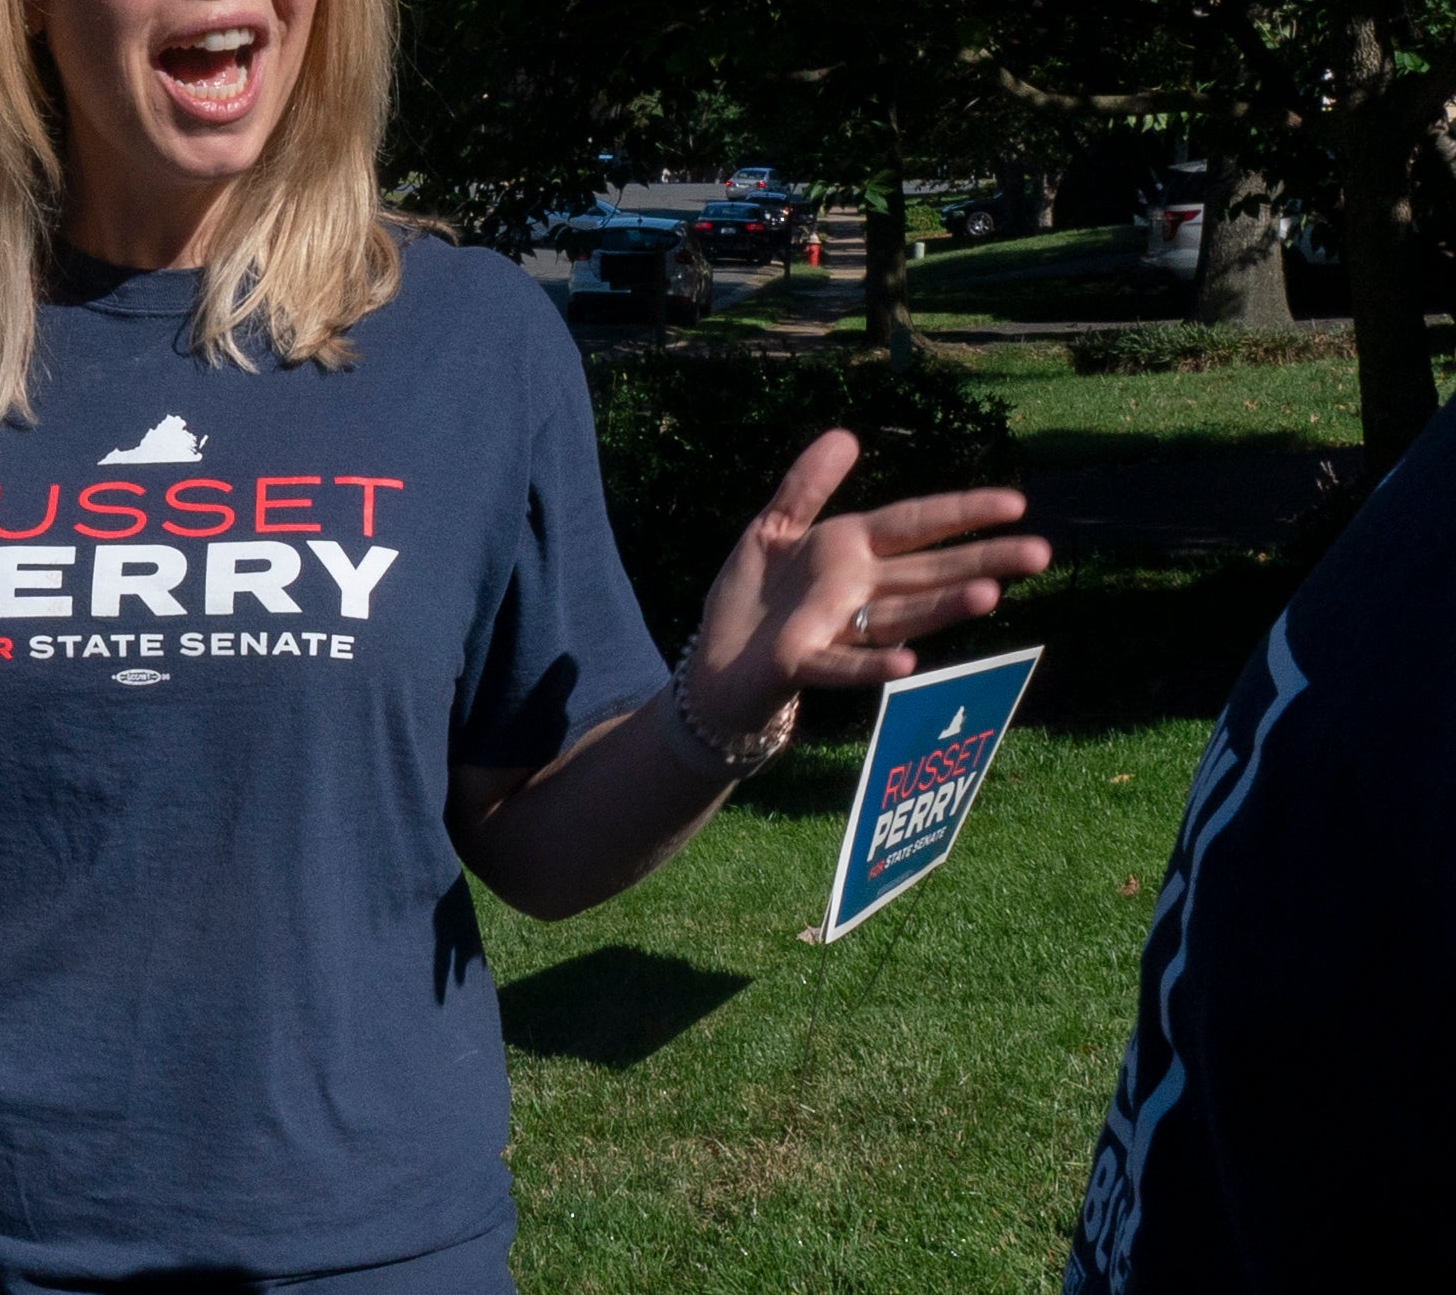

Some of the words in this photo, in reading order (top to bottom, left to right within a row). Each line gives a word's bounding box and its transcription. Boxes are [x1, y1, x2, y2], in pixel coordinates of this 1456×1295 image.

[29, 633, 165, 659] STATE
[180, 631, 356, 660] SENATE
[882, 729, 995, 809] RUSSET
[867, 771, 977, 862] PERRY
[884, 843, 914, 869] STATE
[912, 825, 947, 854] SENATE
